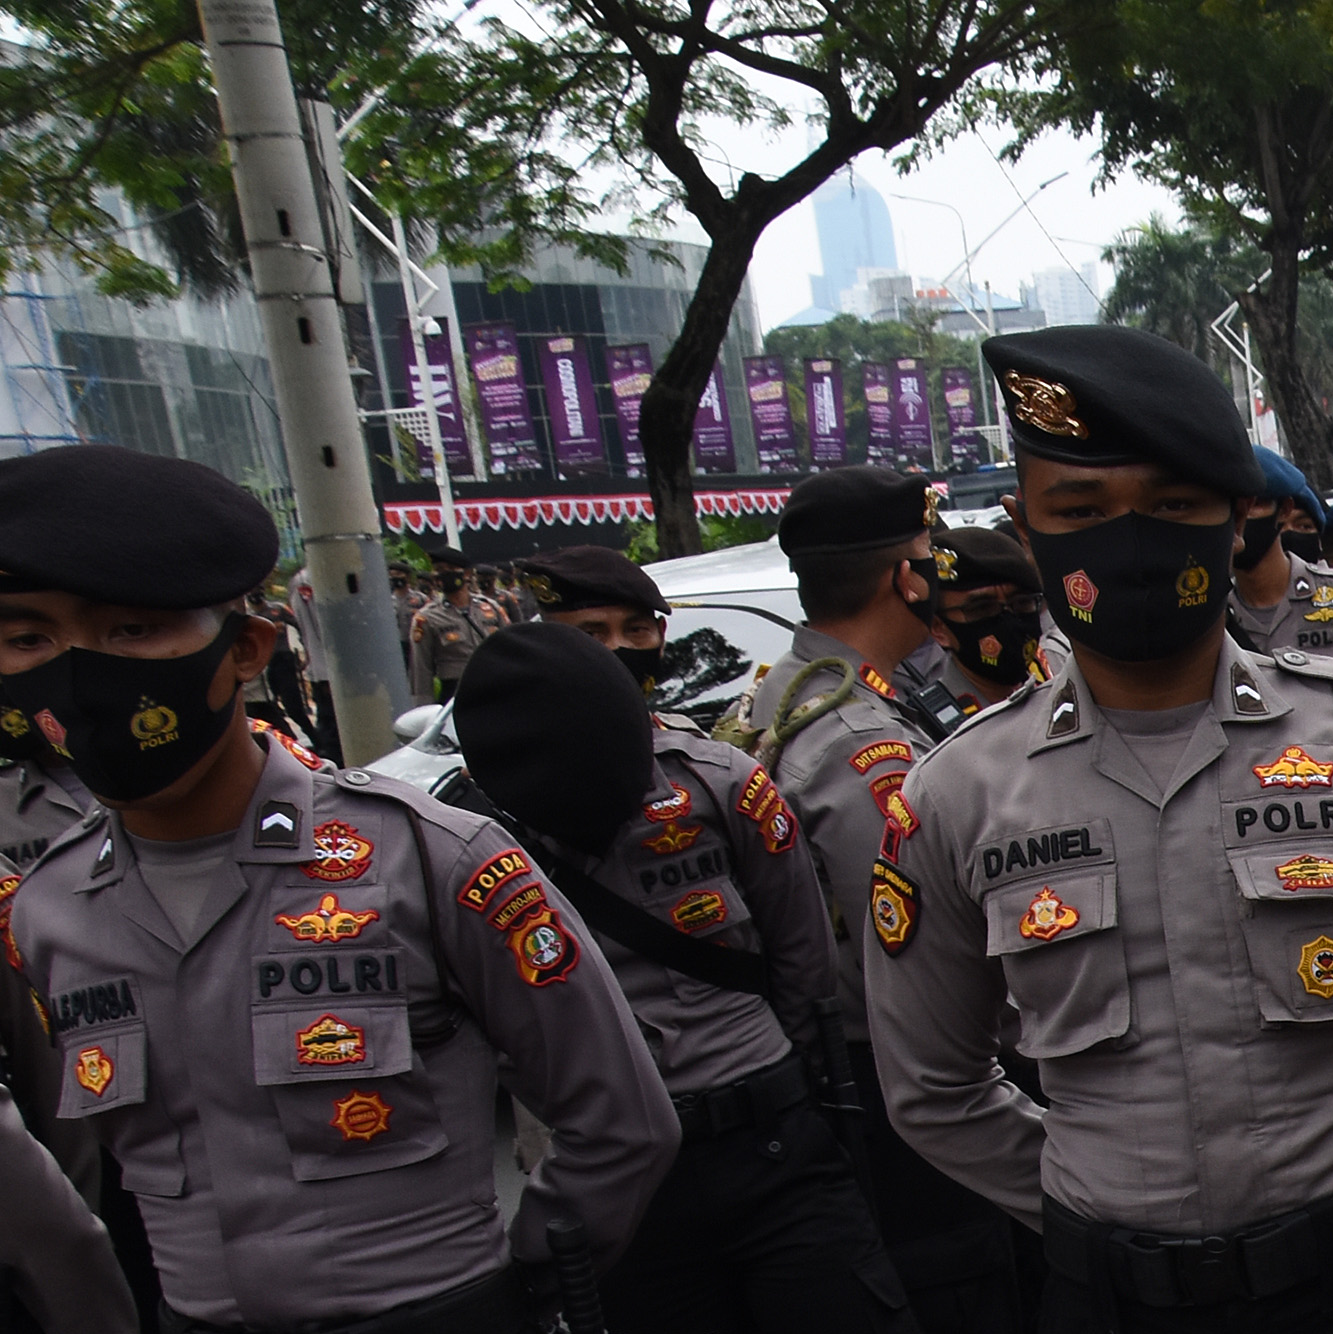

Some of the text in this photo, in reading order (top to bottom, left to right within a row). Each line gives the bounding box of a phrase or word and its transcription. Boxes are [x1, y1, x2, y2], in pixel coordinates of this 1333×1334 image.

[1068, 605, 1093, 624] TNI
[1178, 595, 1208, 608] POLRI
[980, 655, 998, 667] TNI
[139, 731, 180, 751] POLRI
[855, 744, 909, 769] DIT SAMAPTA
[741, 770, 768, 811] POLDA
[983, 828, 1102, 879] DANIEL
[467, 852, 526, 905] POLDA
[640, 849, 723, 895] POLRI
[259, 954, 398, 998] POLRI
